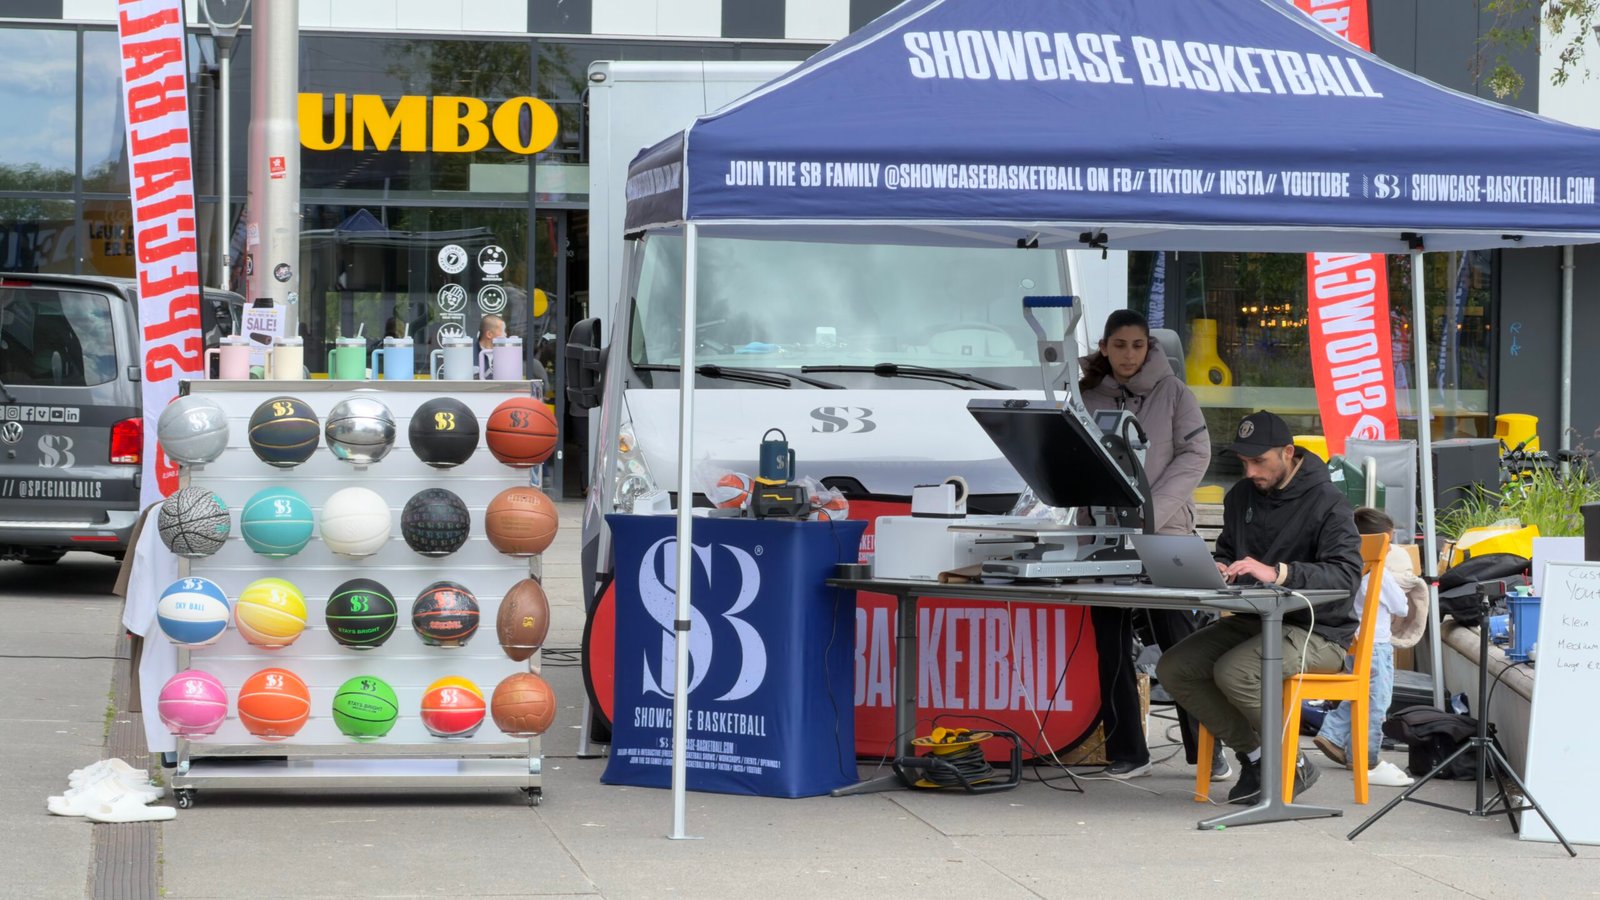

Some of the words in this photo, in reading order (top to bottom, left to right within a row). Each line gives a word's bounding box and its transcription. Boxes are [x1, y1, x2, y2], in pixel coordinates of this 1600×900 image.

[903, 30, 1134, 85] SHOWCASE
[1132, 35, 1384, 98] BASKETBALL
[297, 93, 559, 155] UMBO
[725, 160, 764, 187] JOIN
[767, 160, 796, 187] THE
[800, 161, 822, 188] SB
[825, 162, 880, 188] FAMILY
[884, 163, 1083, 191] @SHOWCASEBASKETBALL
[1087, 167, 1109, 192] ON
[1281, 171, 1350, 197] YOUTUBE
[1411, 173, 1595, 204] SHOWCASE-BASKETBALL.COM
[246, 317, 277, 332] SALE!
[19, 480, 102, 498] @SPECIALBALLS
[854, 607, 1073, 712] BAKETBALL
[1557, 639, 1599, 651] Medium
[1557, 657, 1580, 672] Large
[634, 706, 693, 731] SHOWCE
[697, 710, 766, 736] BASKETBALL
